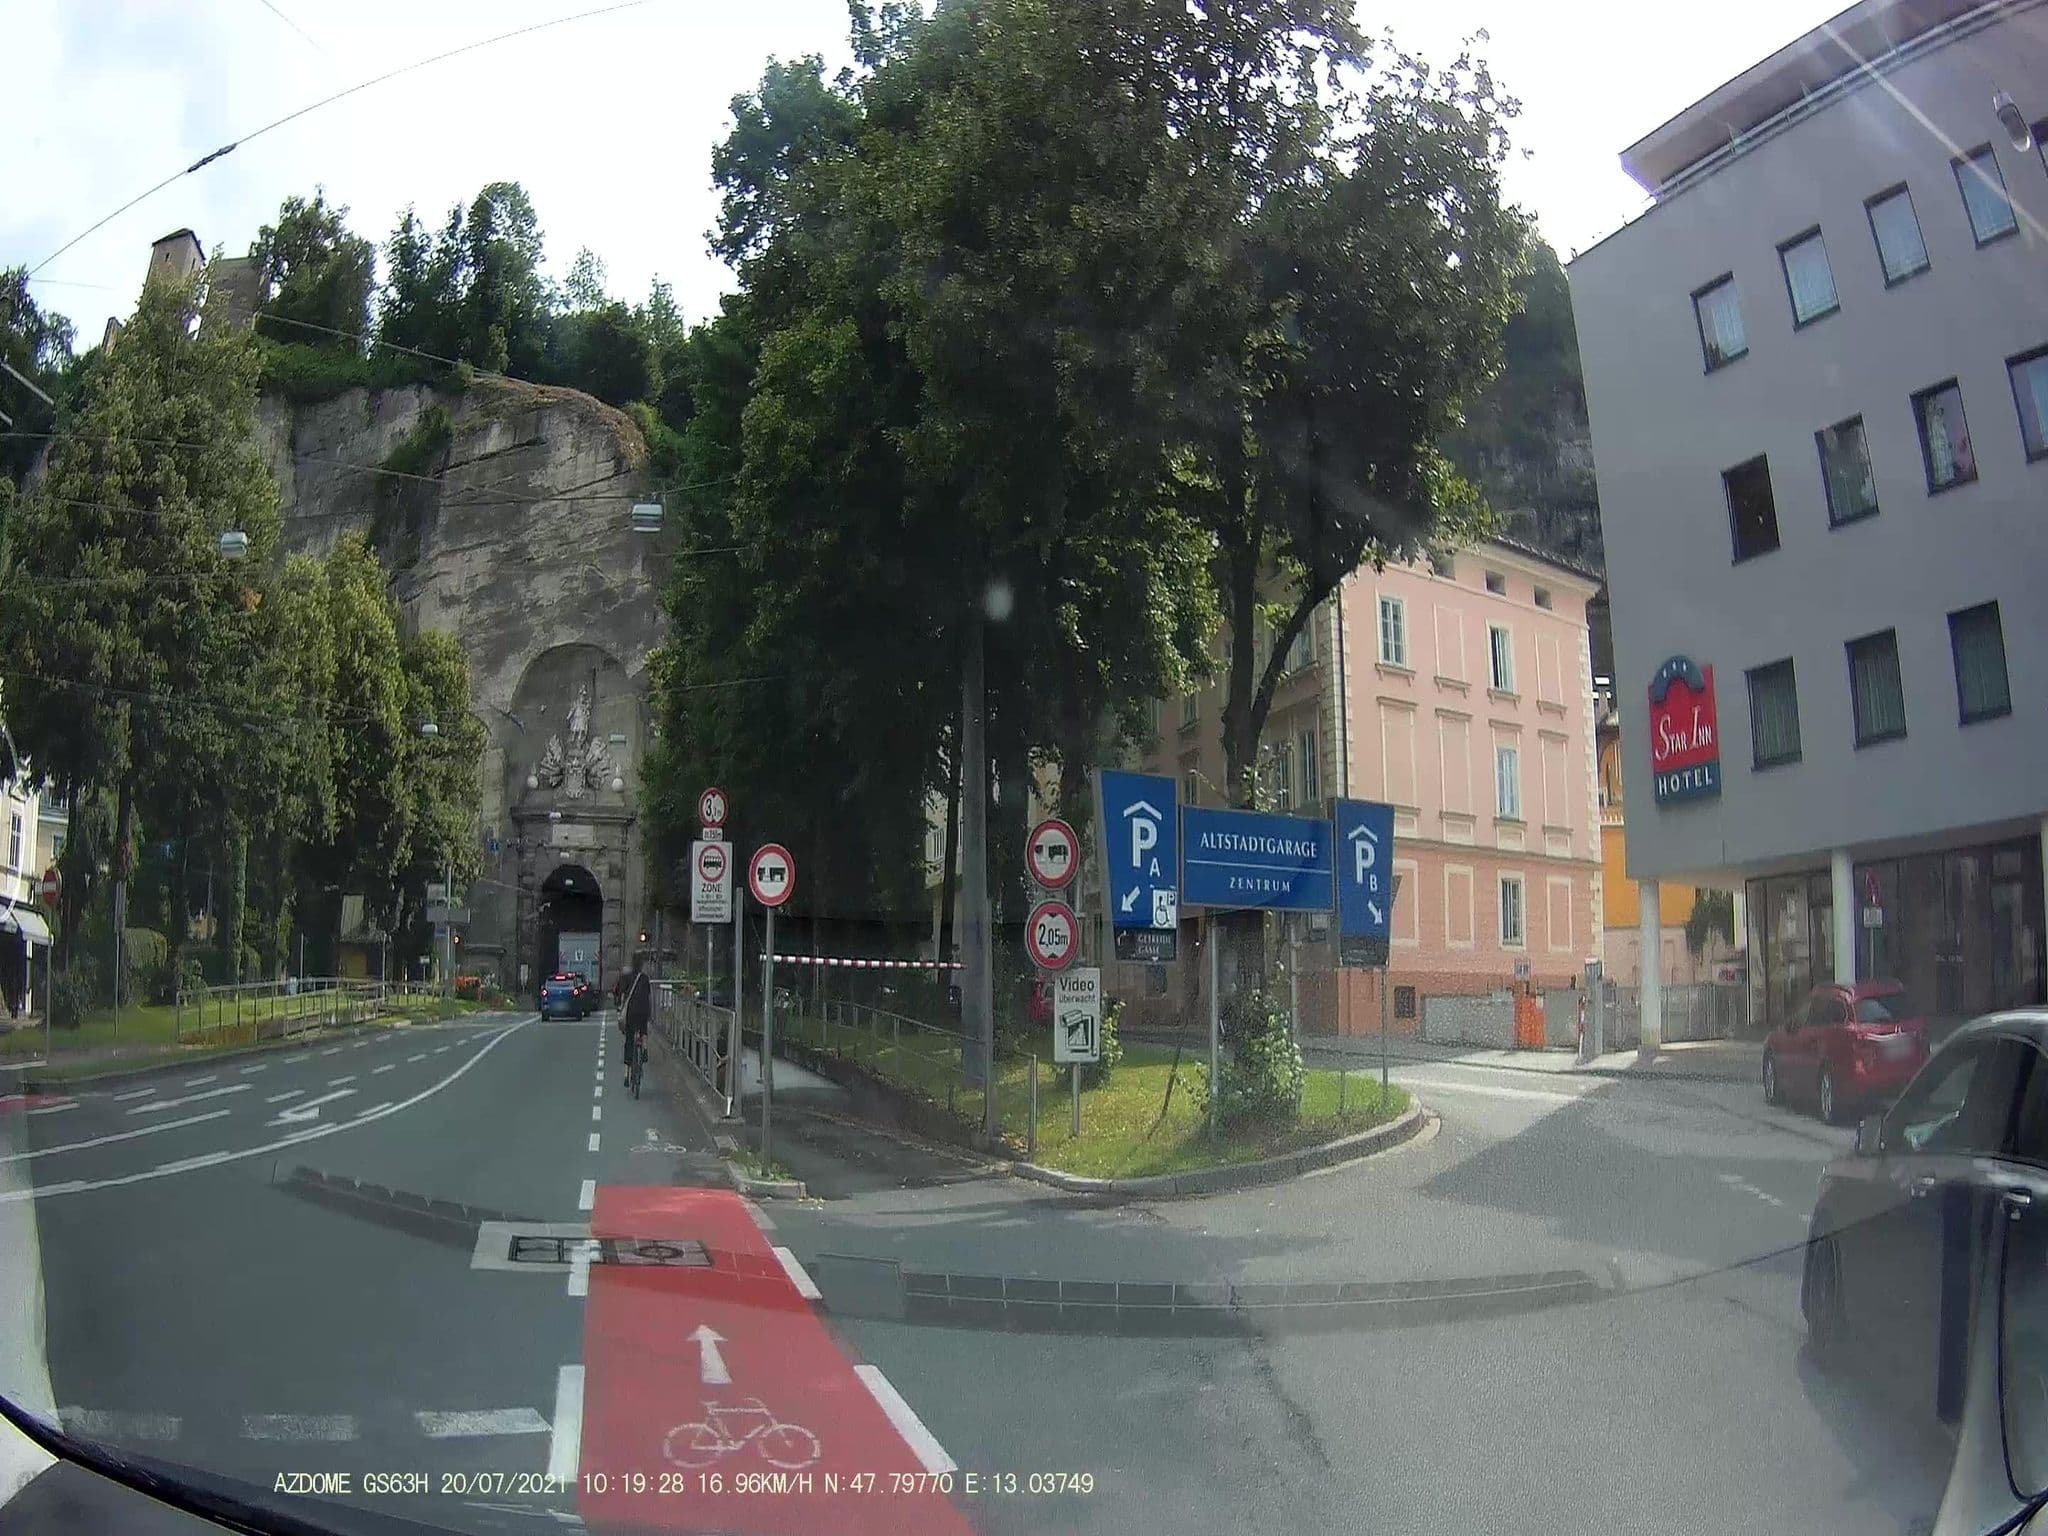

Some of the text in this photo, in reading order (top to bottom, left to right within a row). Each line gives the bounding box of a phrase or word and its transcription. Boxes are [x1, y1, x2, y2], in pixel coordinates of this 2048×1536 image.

[1658, 766, 1712, 796] HOTEL
[1131, 817, 1158, 868] P
[1200, 832, 1318, 858] ALTSTADTGARAGE
[1149, 857, 1161, 877] A
[1354, 839, 1376, 884] P
[701, 883, 723, 893] ZONE
[1229, 876, 1292, 893] ZENTRUM
[1369, 874, 1378, 892] B
[1038, 923, 1069, 947] 2,05m
[1060, 977, 1095, 992] Video
